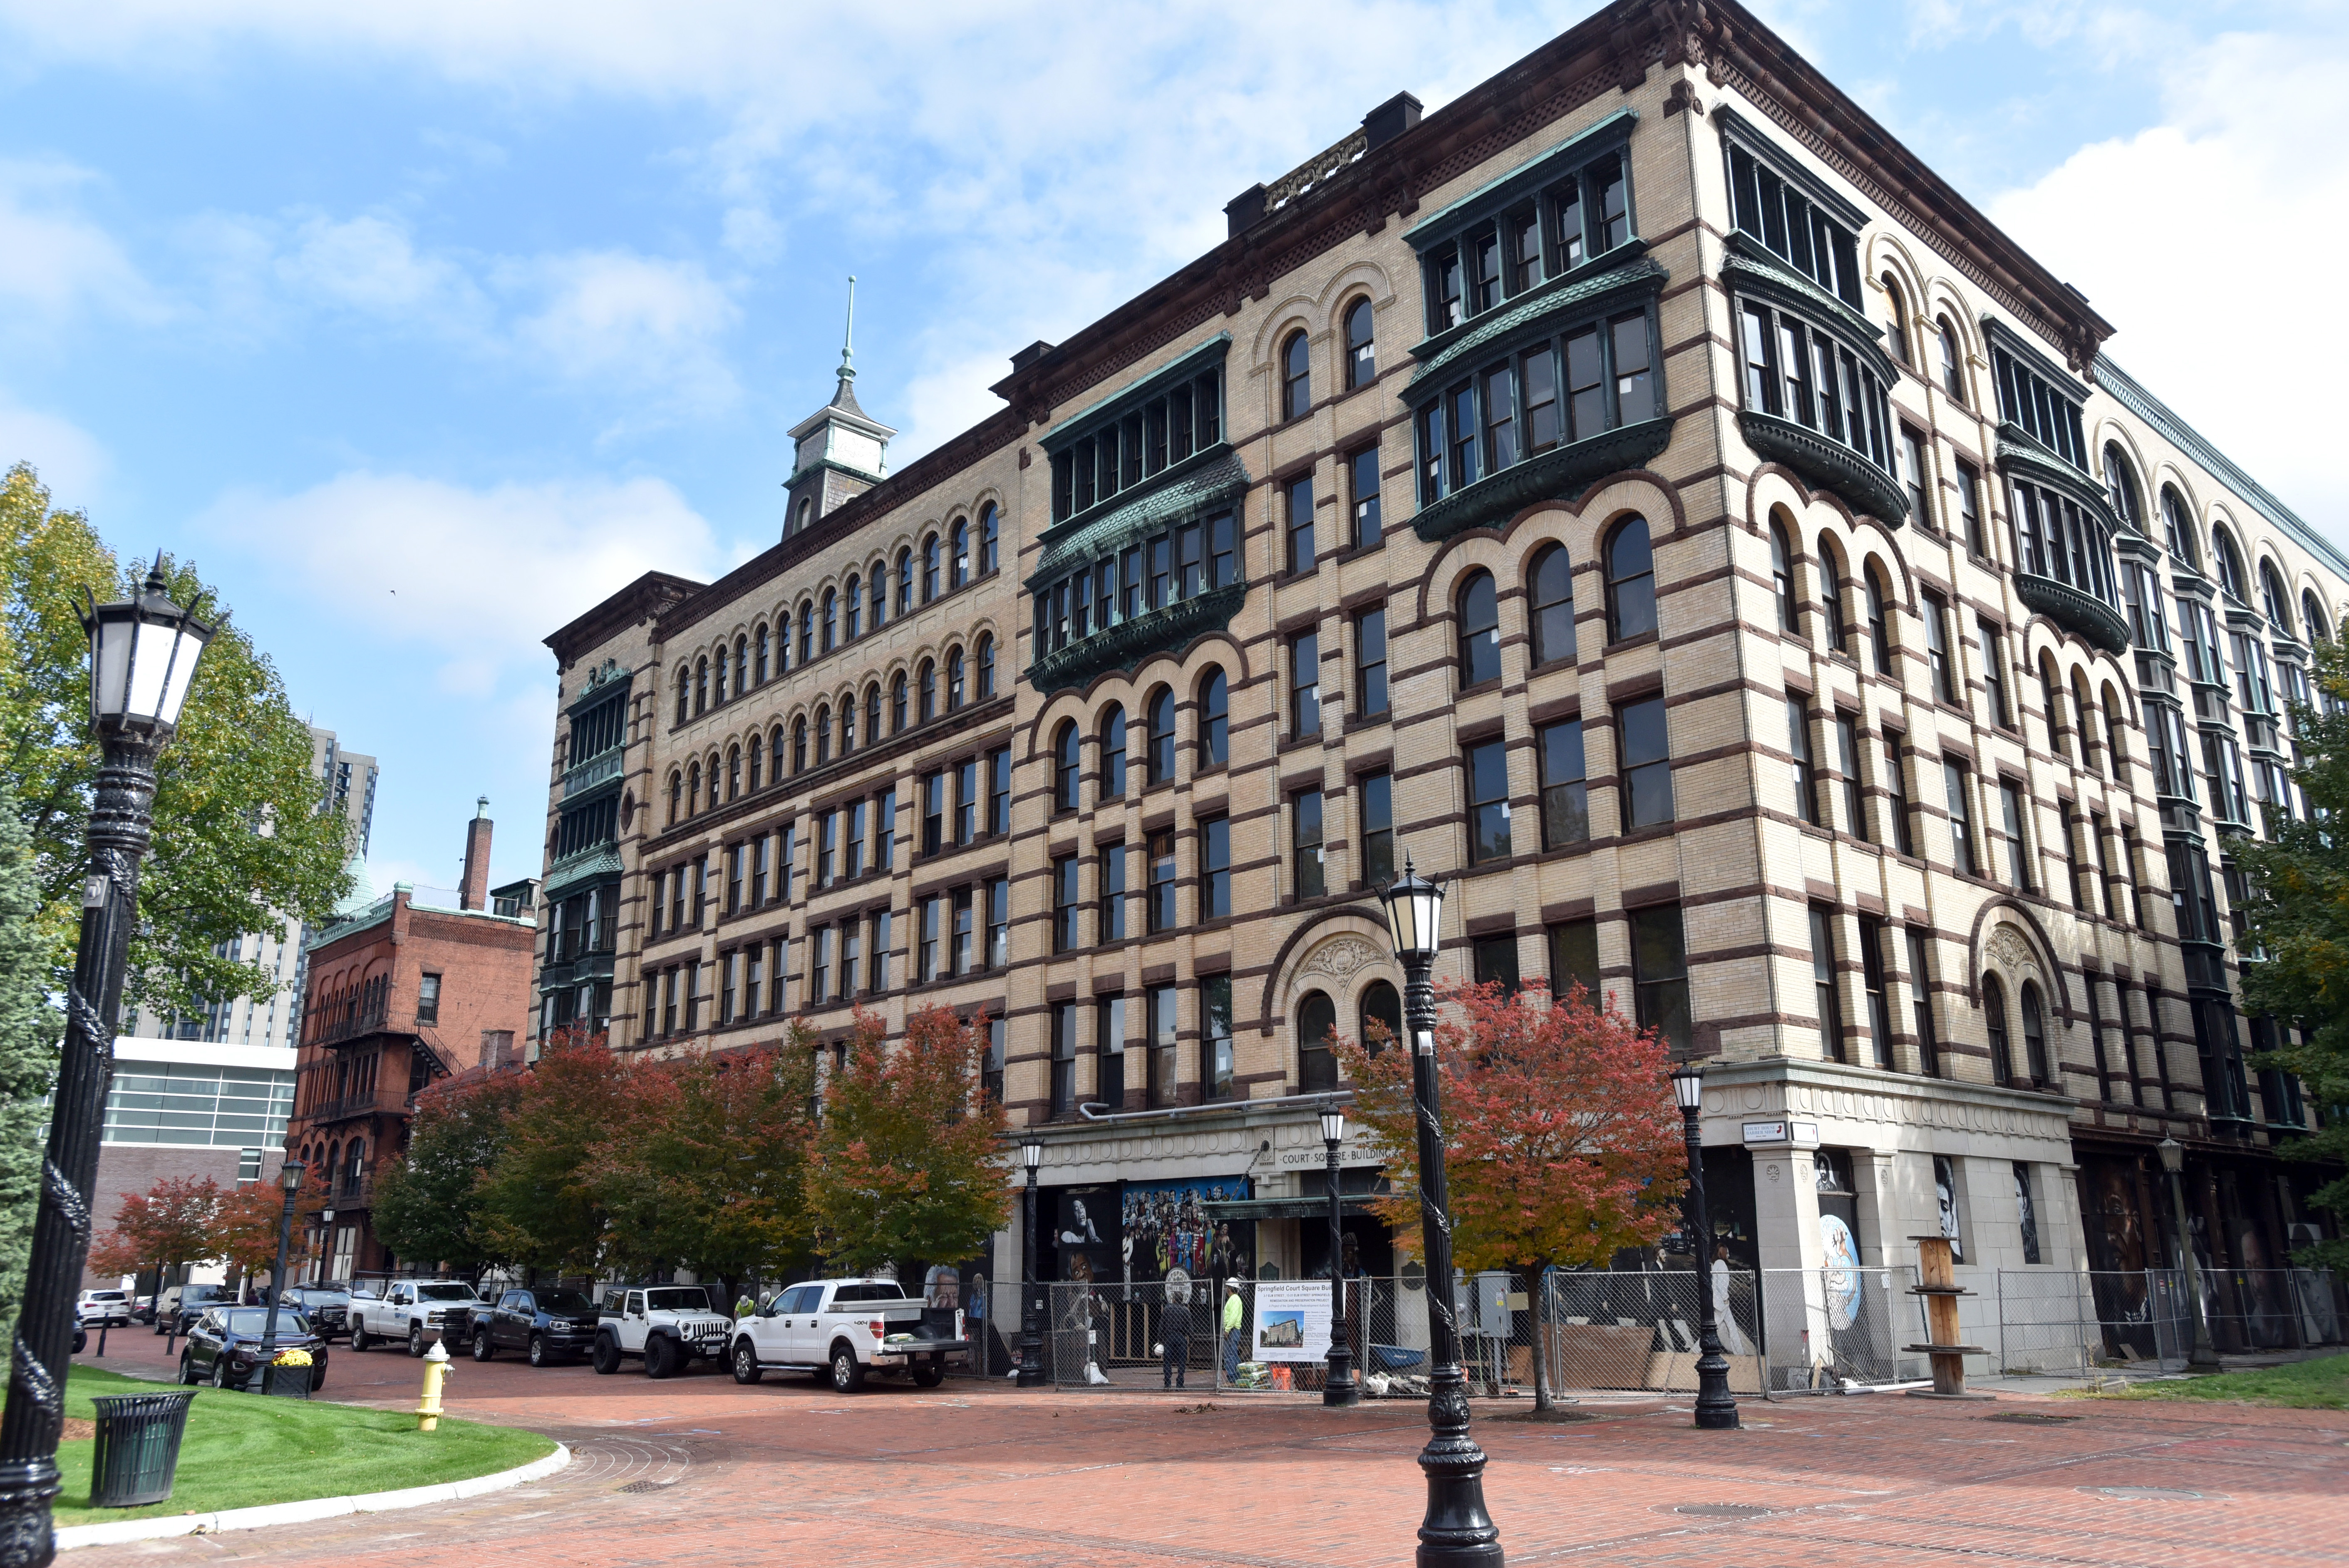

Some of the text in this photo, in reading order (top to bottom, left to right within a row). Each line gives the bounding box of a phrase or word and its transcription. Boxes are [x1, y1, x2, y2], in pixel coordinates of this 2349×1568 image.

[1282, 1149, 1391, 1164] COURT SQRE BUILDING
